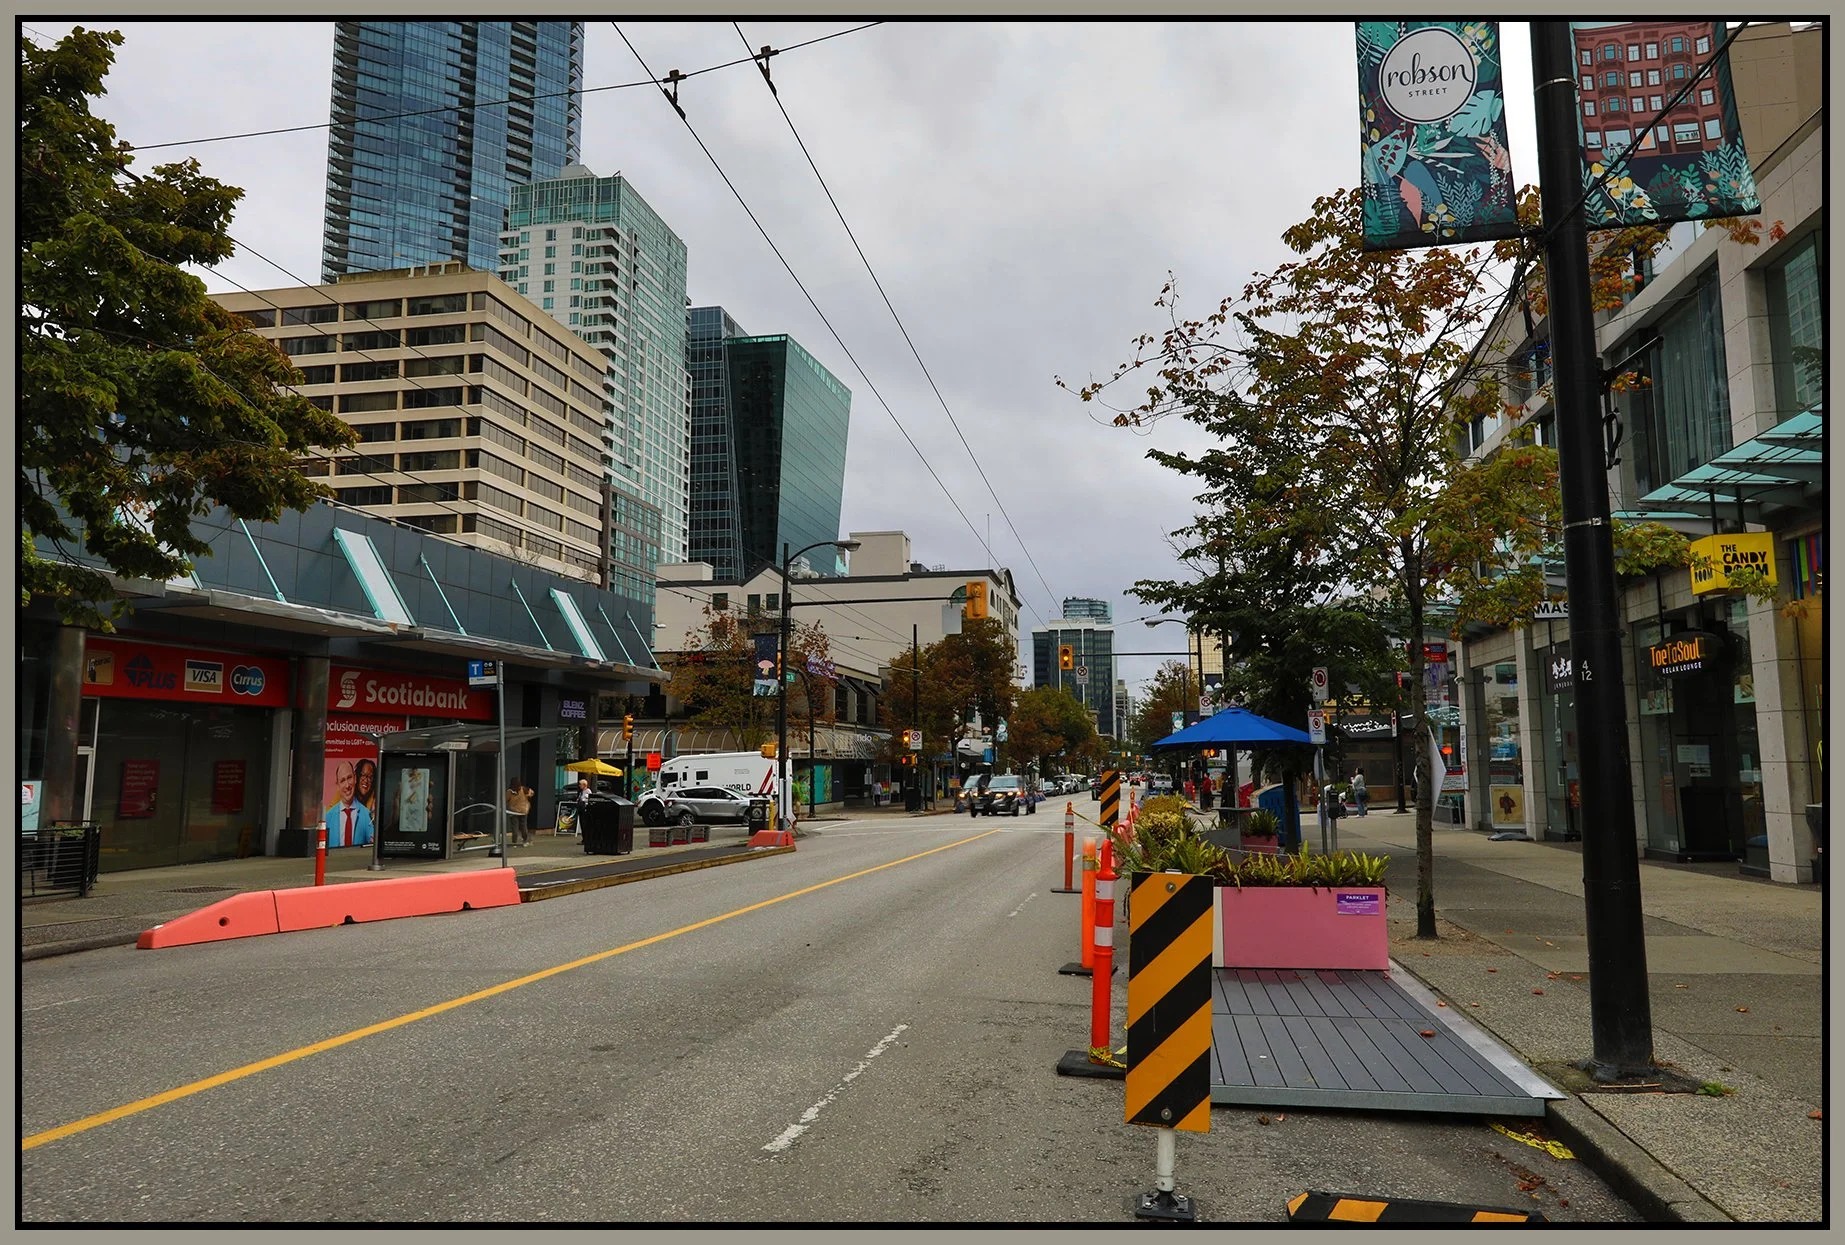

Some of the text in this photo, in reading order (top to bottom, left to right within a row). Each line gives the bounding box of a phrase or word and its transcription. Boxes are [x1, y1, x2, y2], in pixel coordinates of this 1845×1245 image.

[1387, 52, 1473, 88] robson
[1408, 87, 1448, 98] STREET
[1720, 544, 1737, 552] THE
[1722, 551, 1767, 565] CANDY
[471, 664, 479, 675] T
[1582, 660, 1589, 670] 4
[1662, 661, 1702, 674] RELAX LOUNGE
[136, 671, 177, 690] PLUS
[191, 669, 217, 684] VISA
[232, 672, 263, 687] Cirrus
[1581, 670, 1593, 681] 12
[365, 679, 468, 710] Scotiabank
[561, 709, 586, 719] COFFEE
